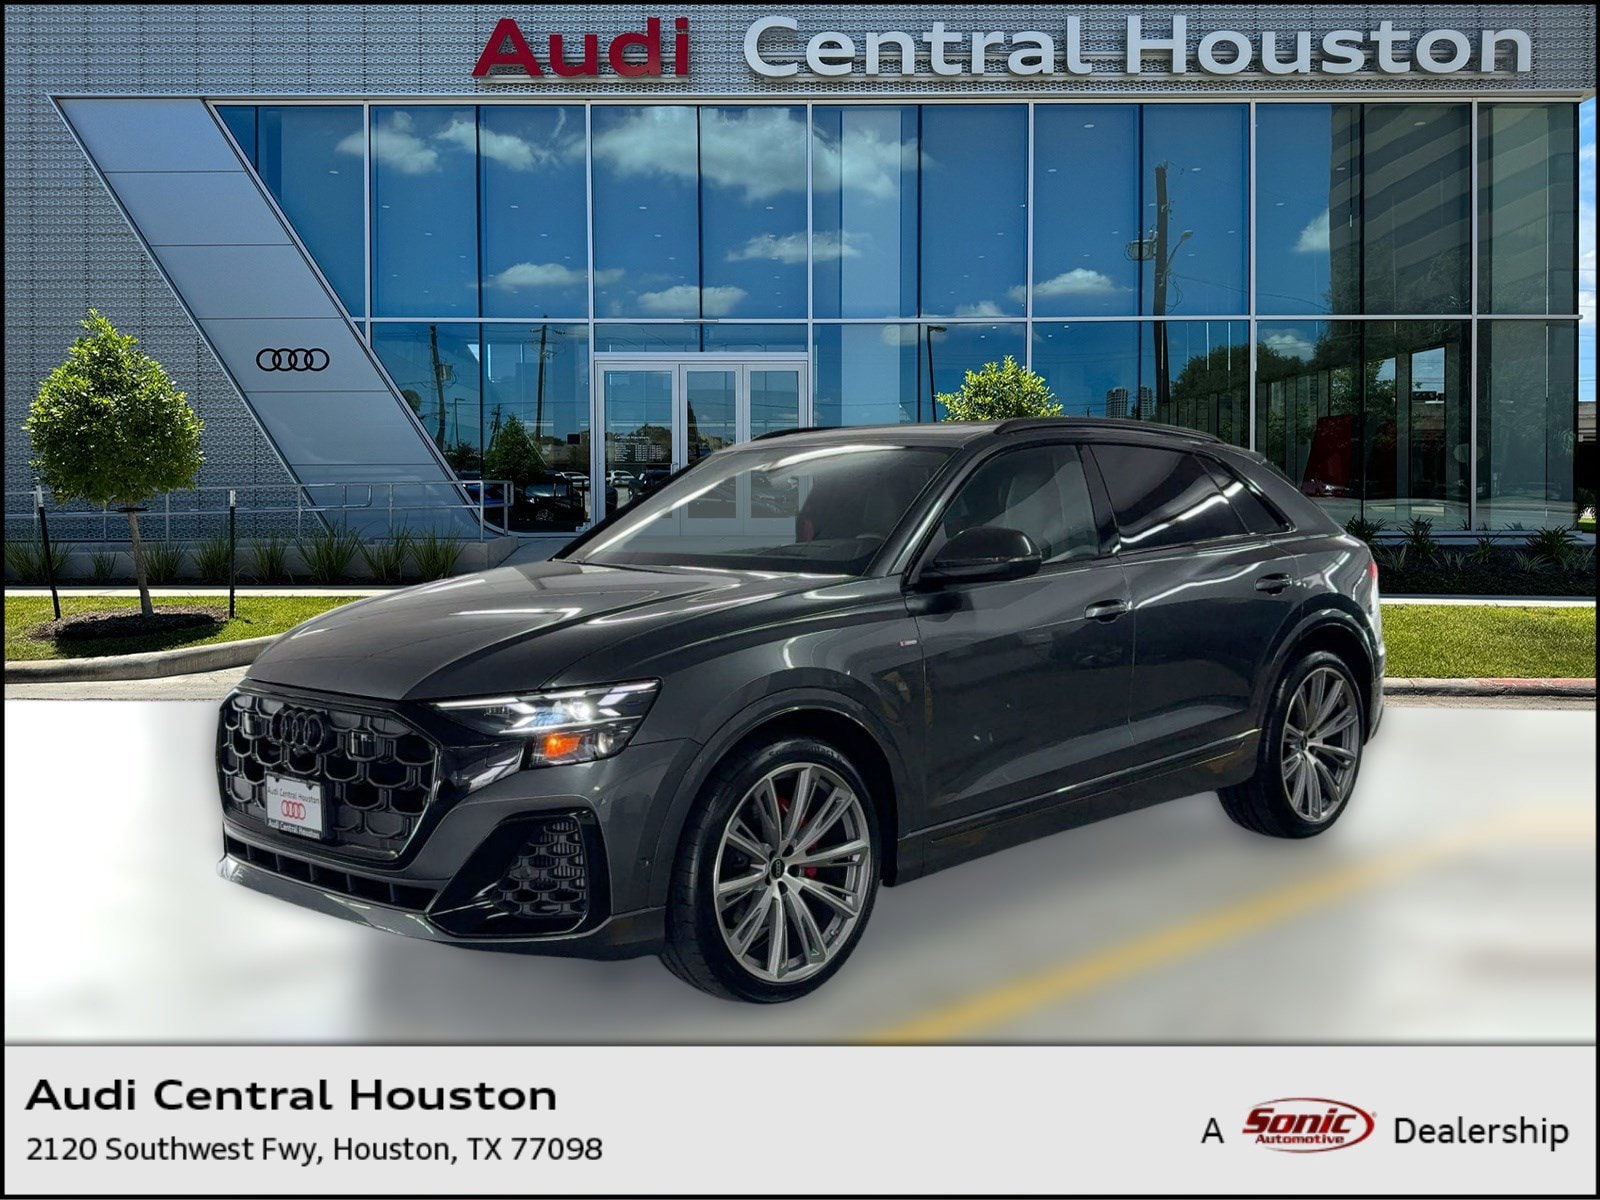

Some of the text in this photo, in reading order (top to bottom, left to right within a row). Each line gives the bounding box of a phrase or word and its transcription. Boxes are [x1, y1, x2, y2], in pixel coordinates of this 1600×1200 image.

[472, 15, 1532, 77] Audi Central Houston
[280, 788, 297, 800] Central
